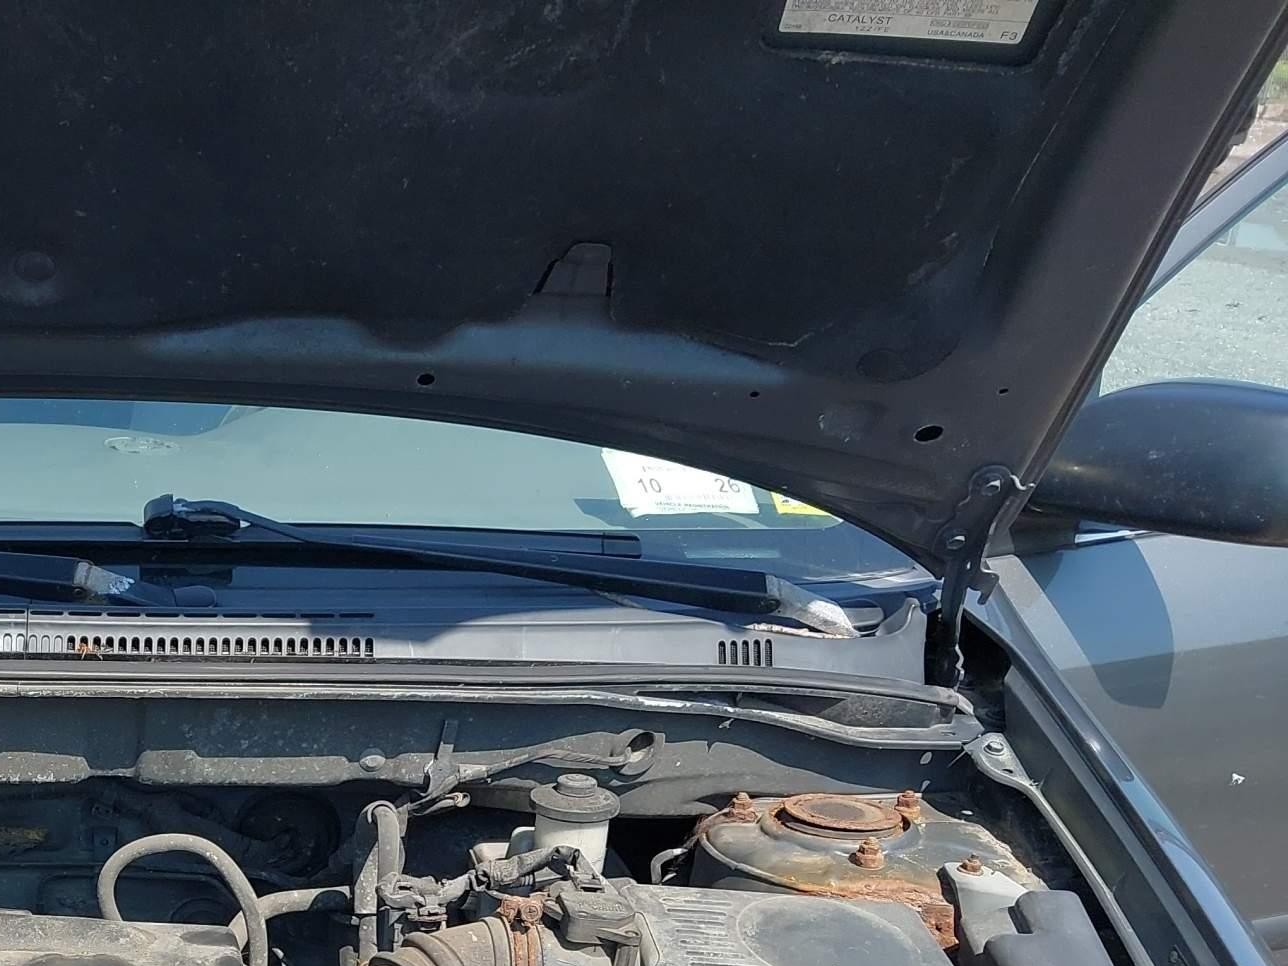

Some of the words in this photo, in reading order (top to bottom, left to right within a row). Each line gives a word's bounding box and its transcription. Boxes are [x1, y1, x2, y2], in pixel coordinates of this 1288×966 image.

[827, 13, 893, 25] CATALYST
[927, 29, 985, 39] USA&CANADA
[999, 31, 1018, 41] F3
[637, 477, 662, 494] 10
[714, 477, 741, 494] 26
